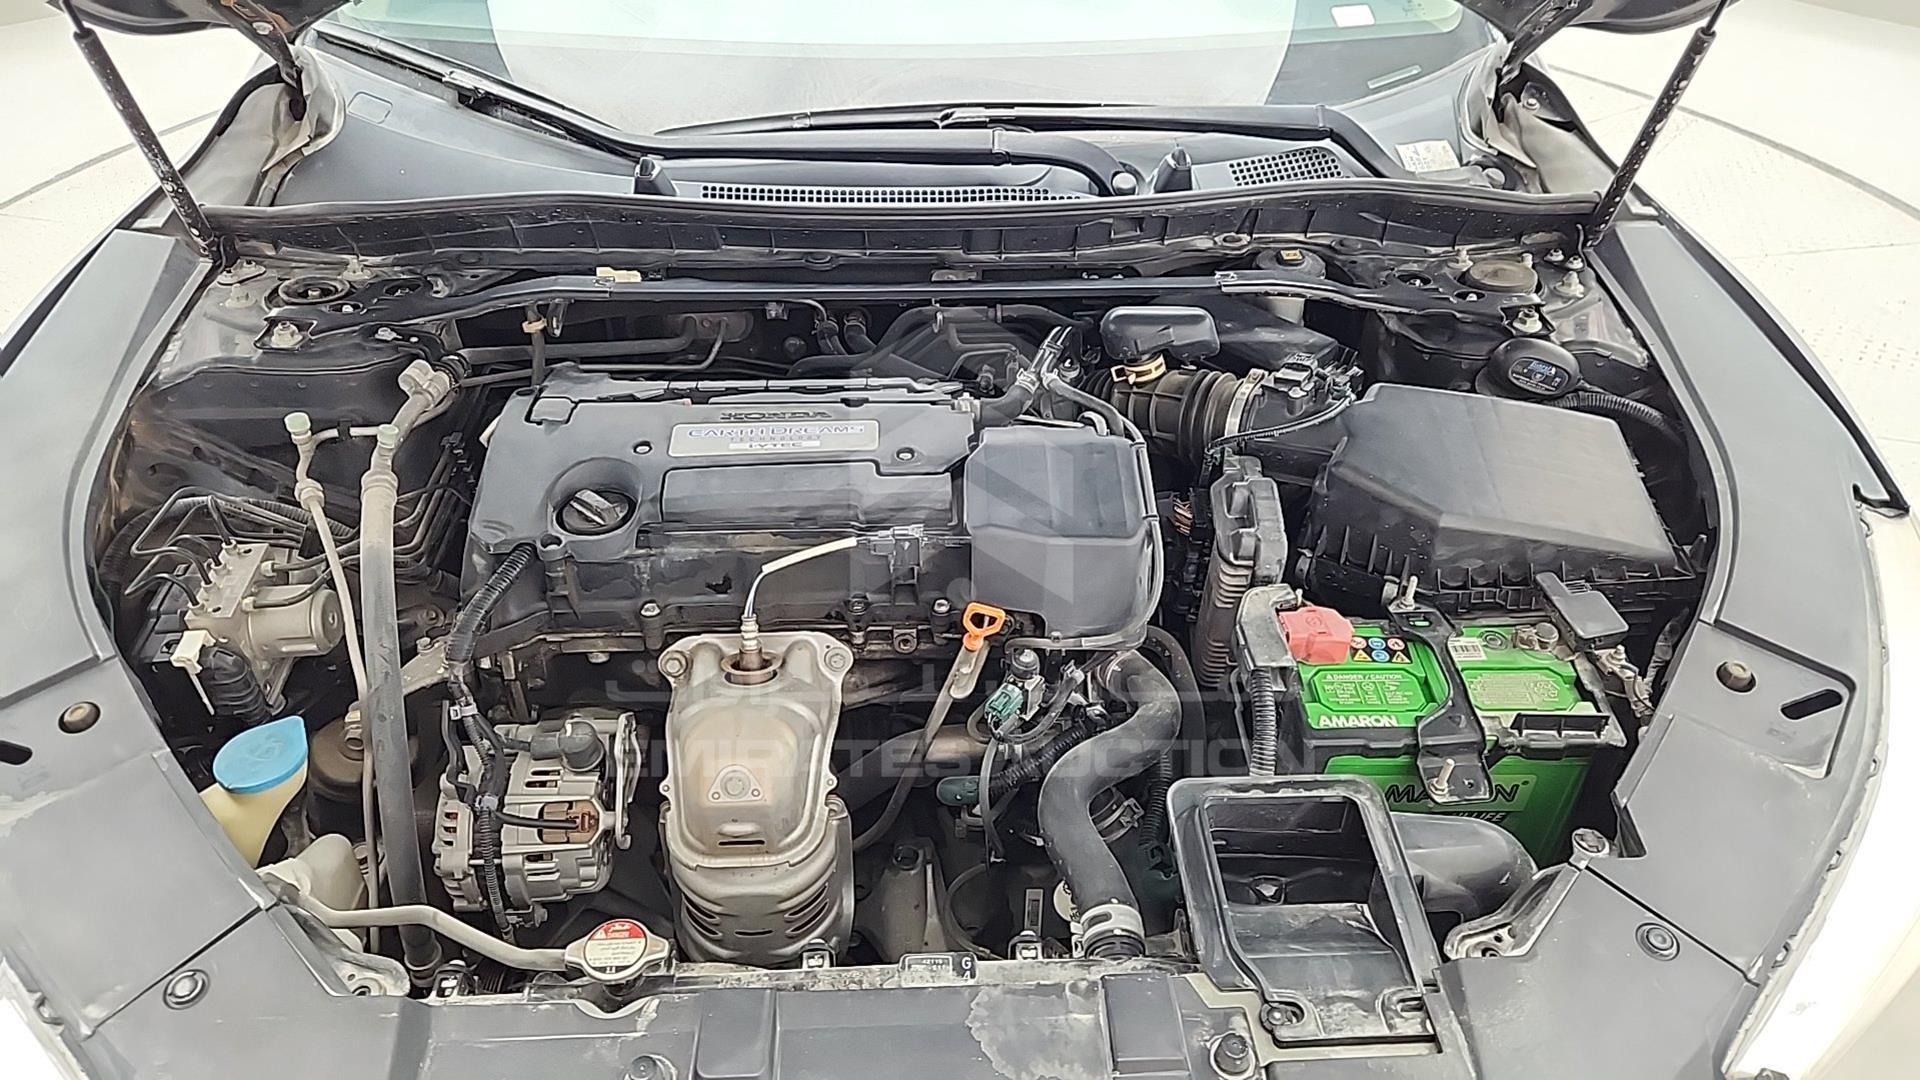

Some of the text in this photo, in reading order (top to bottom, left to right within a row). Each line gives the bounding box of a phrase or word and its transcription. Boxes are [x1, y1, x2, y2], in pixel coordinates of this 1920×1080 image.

[720, 411, 832, 420] HONDA
[688, 425, 865, 438] EARTH DREAMS
[1319, 714, 1398, 728] AMARON
